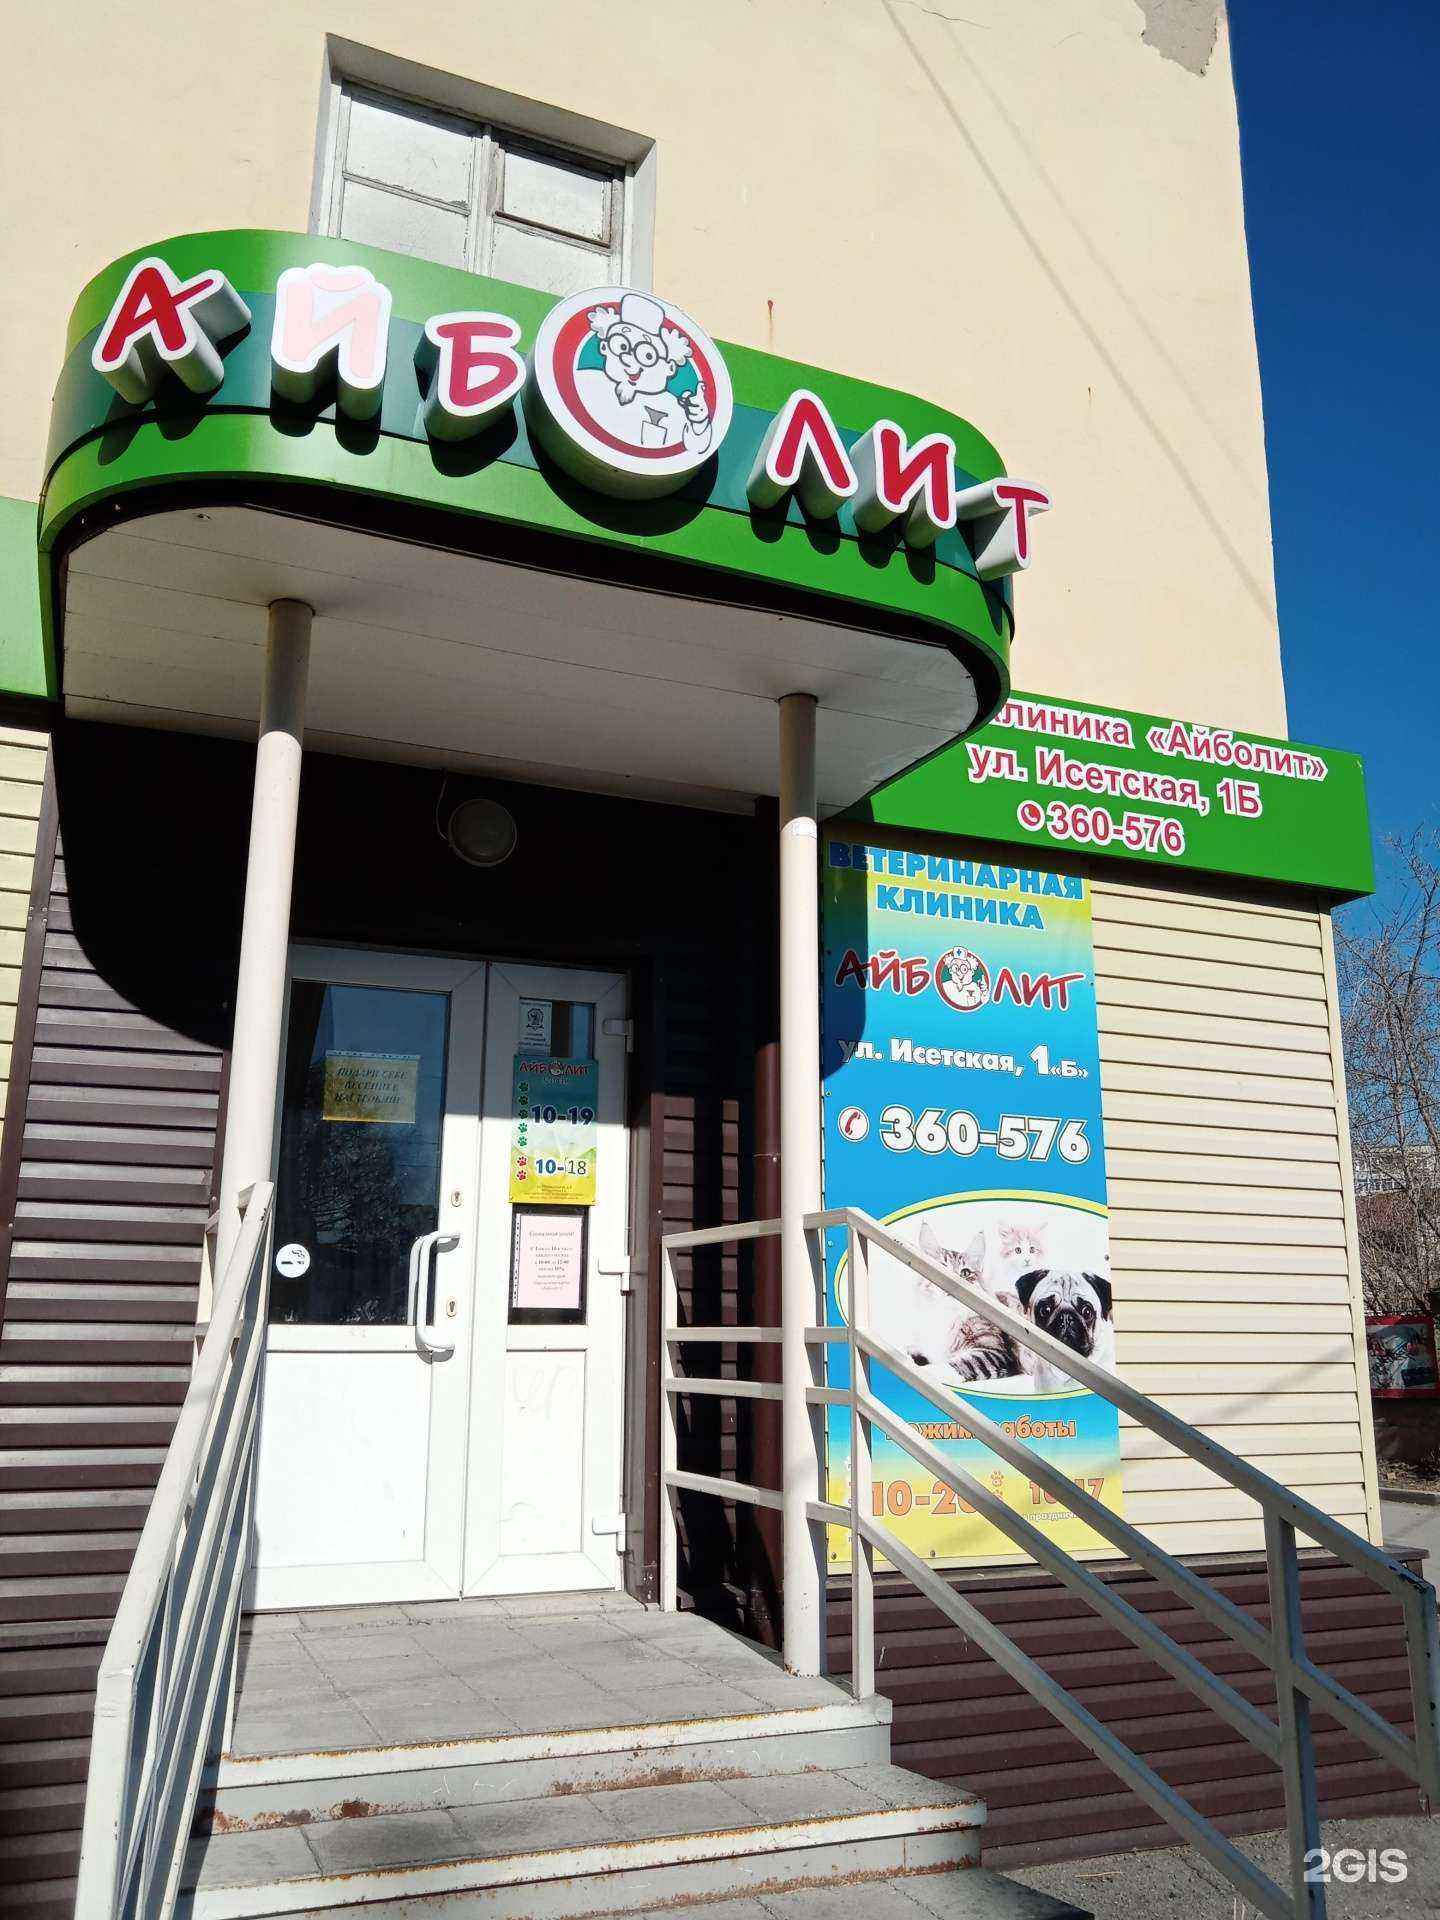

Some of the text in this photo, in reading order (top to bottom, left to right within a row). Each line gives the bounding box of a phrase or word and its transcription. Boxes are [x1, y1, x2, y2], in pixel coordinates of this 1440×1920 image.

[994, 700, 1327, 779] линика «Айболит»
[968, 746, 1260, 815] ул. Исетская, 1Б
[1049, 802, 1184, 853] 360-576
[829, 841, 1083, 899] ВЕТЕРИНАРНАЯ
[877, 884, 1045, 929] КЛИНИКА
[890, 1037, 1024, 1078] Исетская,
[530, 1105, 594, 1125] 10-19
[880, 1103, 1090, 1165] 360-576
[535, 1158, 587, 1175] 10-18
[992, 1414, 1077, 1438] аботы
